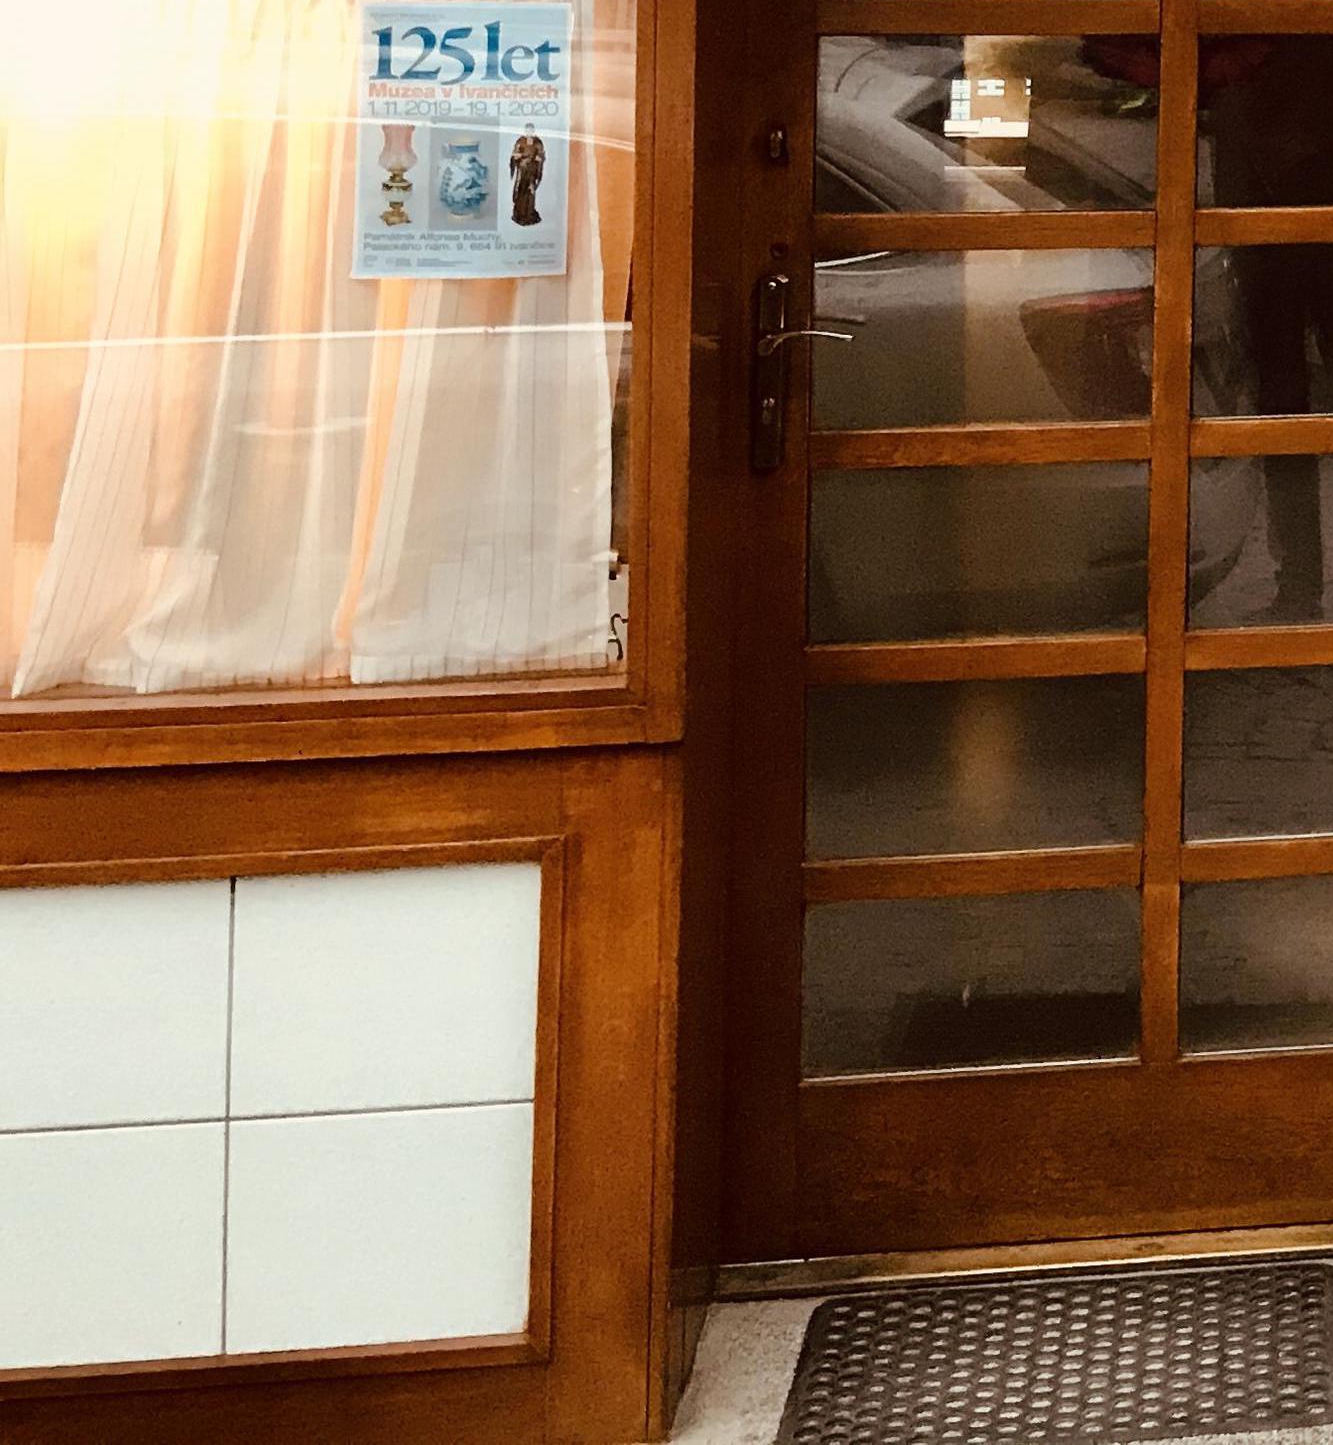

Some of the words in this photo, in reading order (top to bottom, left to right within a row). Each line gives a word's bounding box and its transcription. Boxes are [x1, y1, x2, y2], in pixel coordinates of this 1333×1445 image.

[369, 25, 476, 86] 125
[481, 20, 561, 81] let
[368, 83, 436, 98] Muzea
[442, 86, 455, 98] v
[459, 82, 560, 99] Ivančicích
[509, 101, 560, 116] 2020
